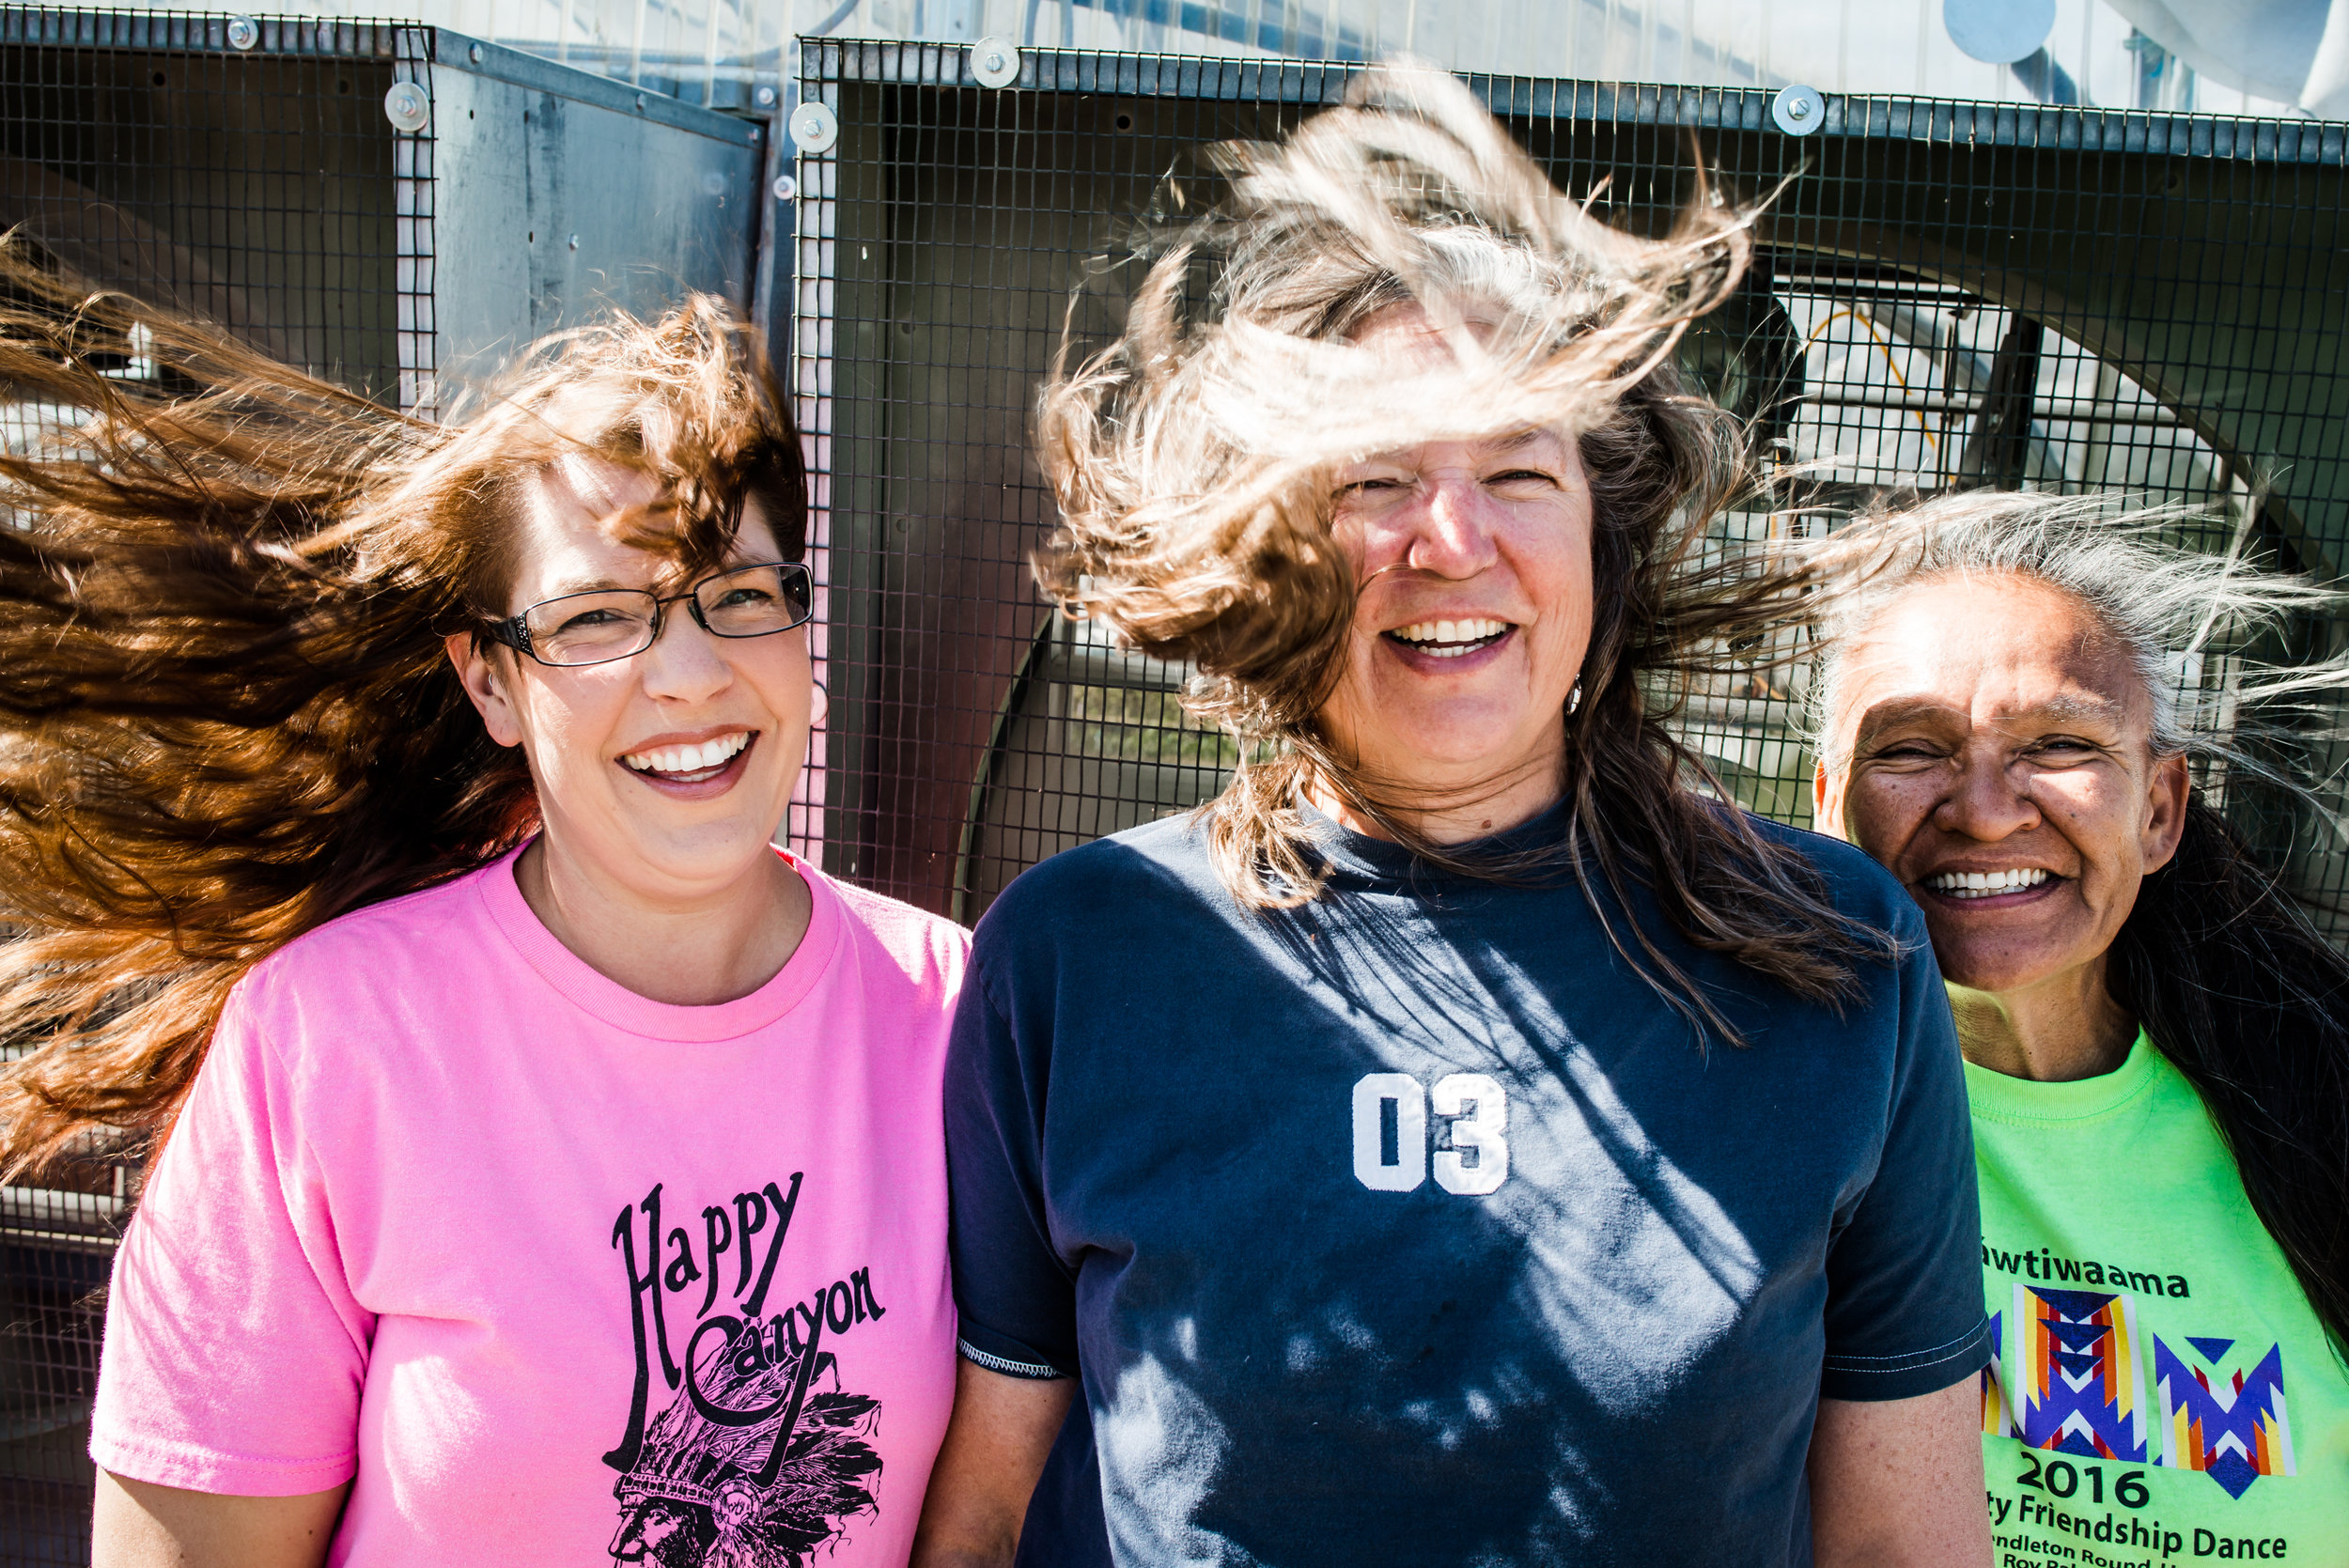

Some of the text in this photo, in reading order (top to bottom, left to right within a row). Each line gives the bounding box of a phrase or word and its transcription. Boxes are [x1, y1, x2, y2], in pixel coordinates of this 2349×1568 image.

[1352, 1073, 1508, 1195] 03
[602, 1172, 803, 1475] Happy
[686, 1266, 885, 1488] Canyon
[2017, 1452, 2150, 1509] 2016
[2019, 1494, 2183, 1559] Friendship
[2194, 1529, 2287, 1559] Dance
[1992, 1534, 2076, 1559] ndleton
